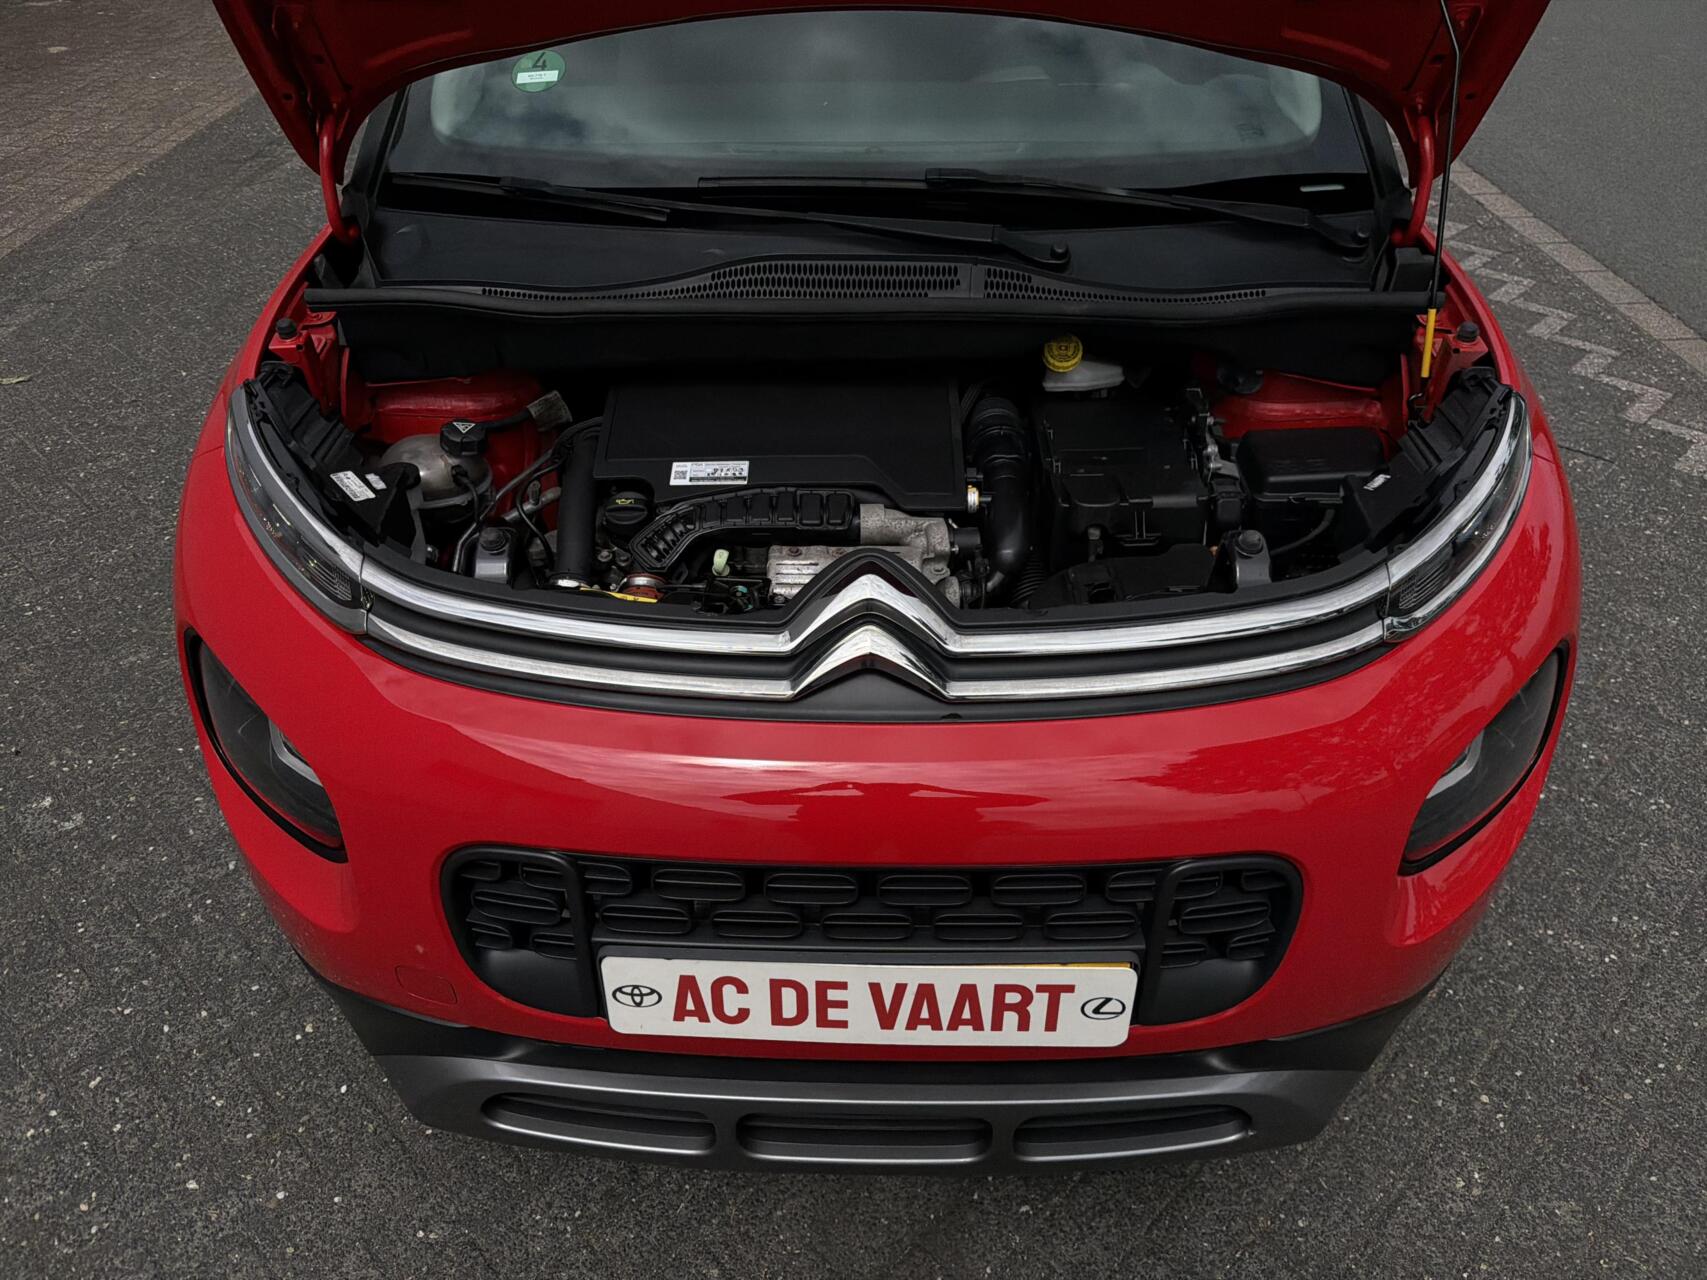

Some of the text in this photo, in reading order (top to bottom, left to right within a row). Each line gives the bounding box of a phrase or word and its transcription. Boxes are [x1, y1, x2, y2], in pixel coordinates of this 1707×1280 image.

[531, 51, 547, 70] 4
[672, 974, 1076, 1032] AC DE VAART
